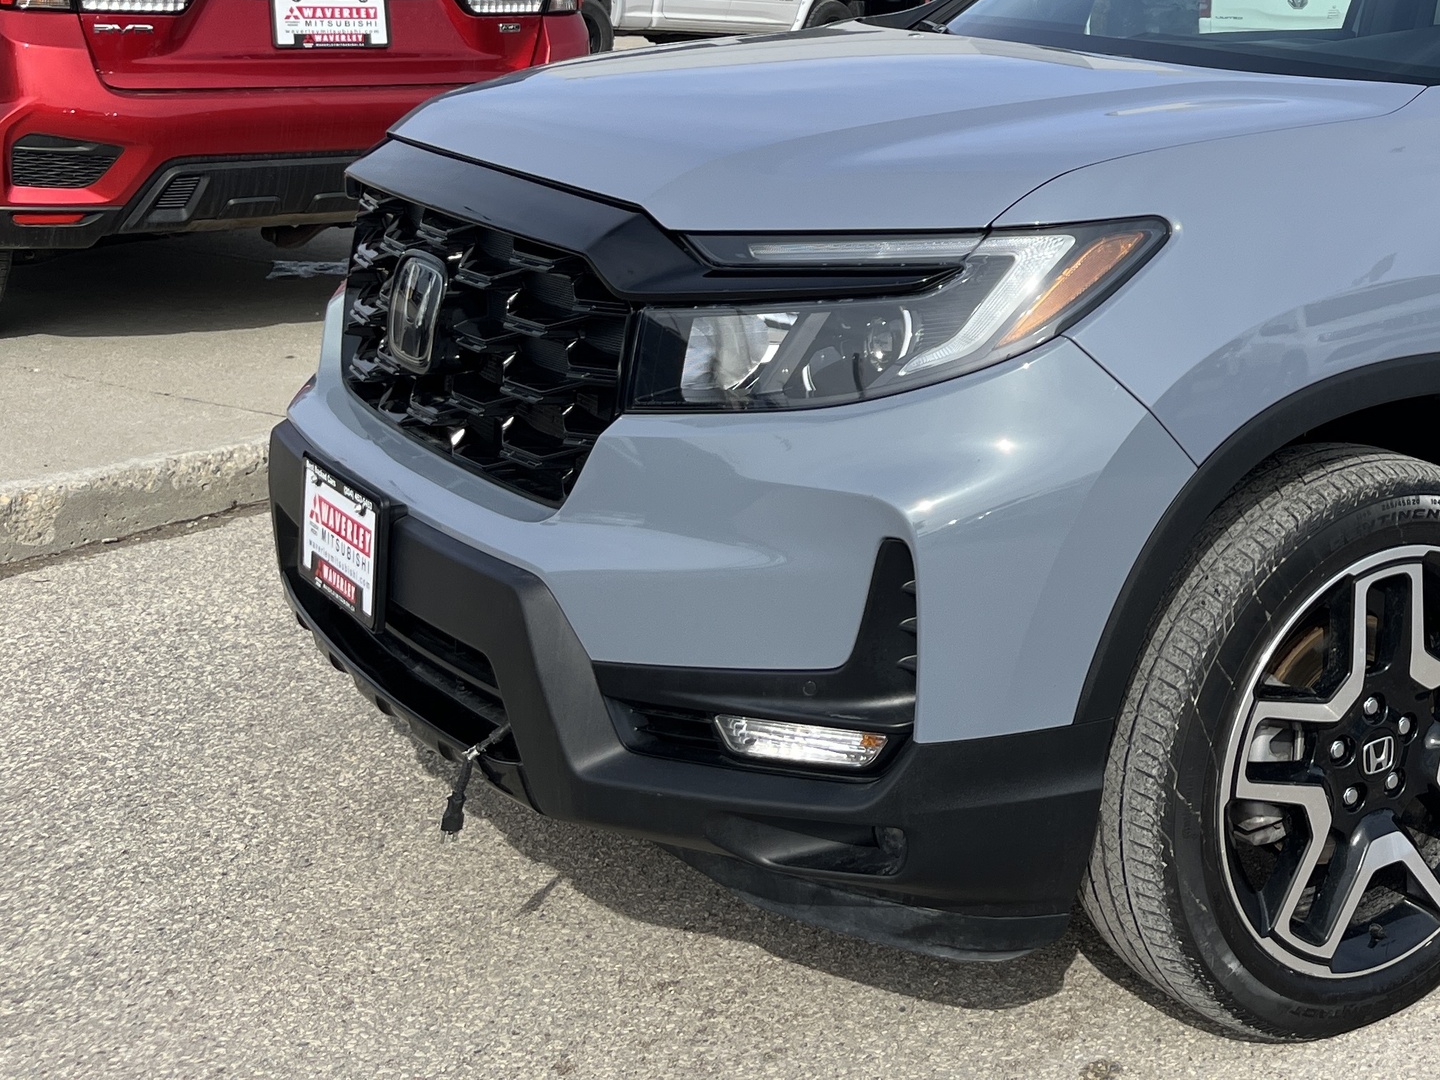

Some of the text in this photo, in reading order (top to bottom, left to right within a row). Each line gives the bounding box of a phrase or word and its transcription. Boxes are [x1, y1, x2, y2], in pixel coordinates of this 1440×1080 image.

[302, 7, 376, 19] WAVERLEY
[93, 23, 154, 34] RVR
[314, 34, 363, 42] WAVERLEY
[321, 500, 372, 555] WAVERLEY
[321, 527, 370, 575] MITSUBISHI
[323, 563, 356, 601] WAVERLEY
